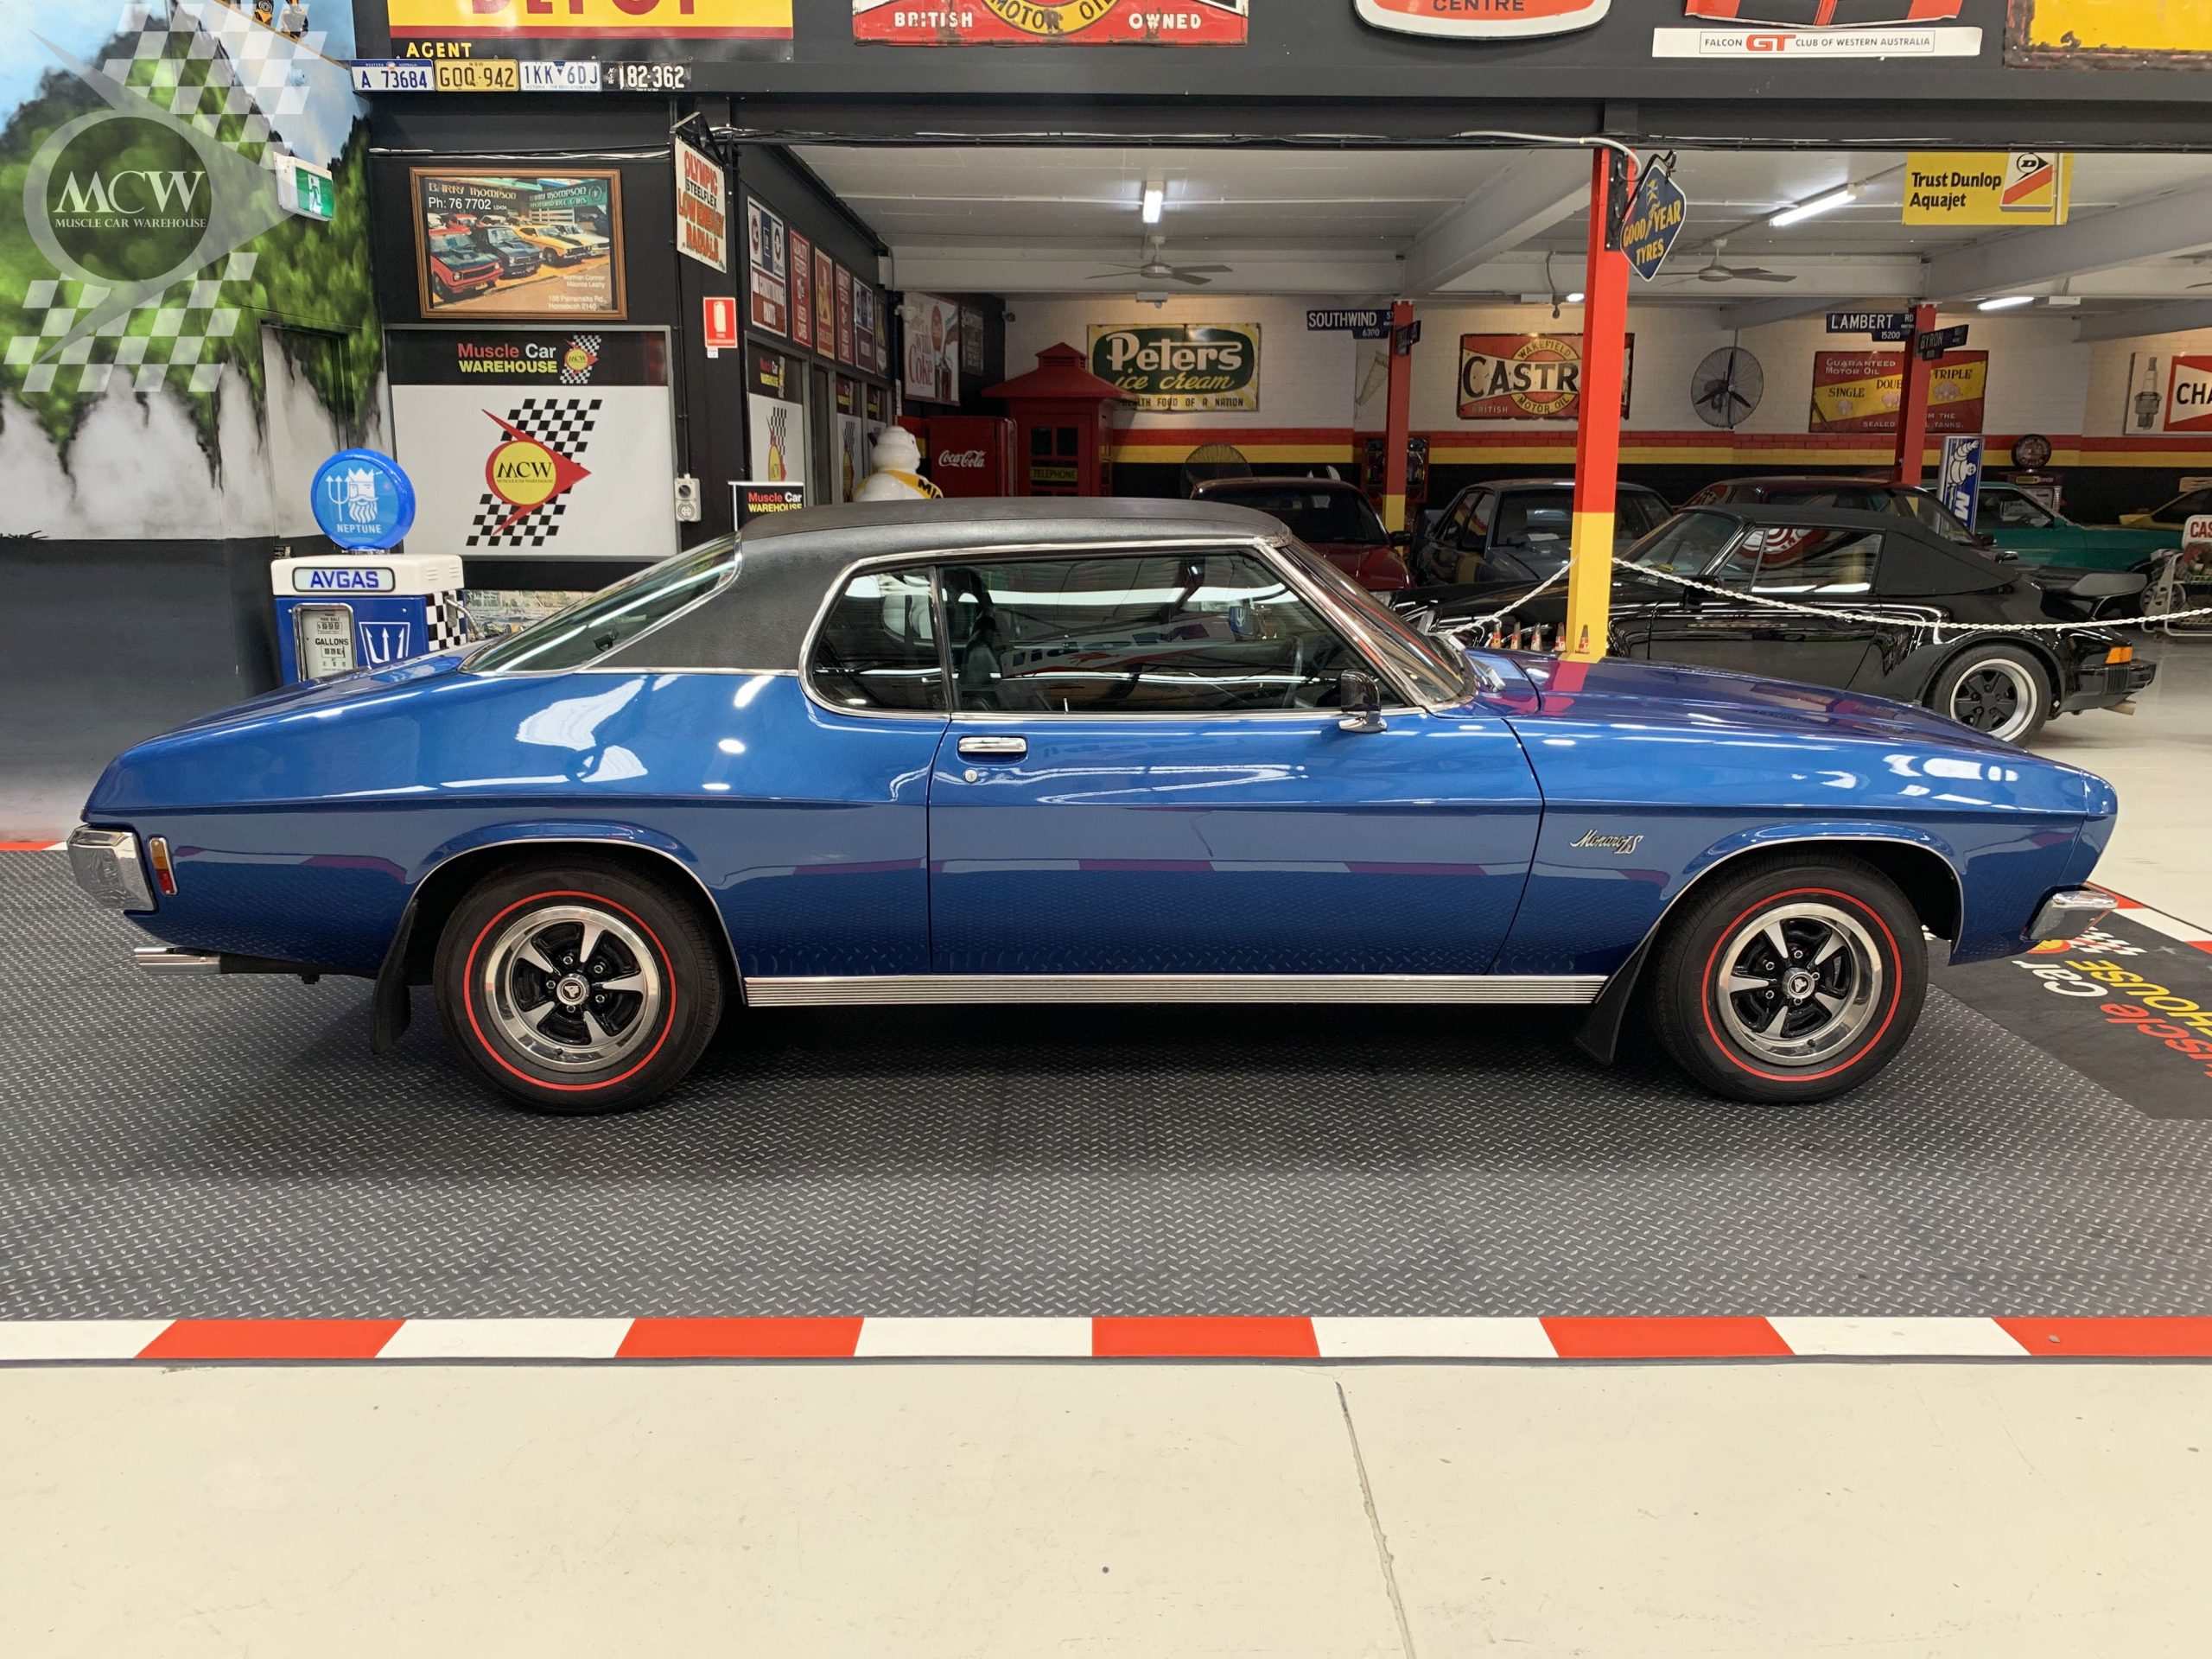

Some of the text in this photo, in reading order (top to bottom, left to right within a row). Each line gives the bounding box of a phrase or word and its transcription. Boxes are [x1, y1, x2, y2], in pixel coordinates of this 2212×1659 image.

[894, 12, 1202, 29] BRITISH OWNED
[406, 42, 472, 58] AGENT
[1705, 34, 1930, 52] FALCON GT CLUB OF WESTERN AUSTRALIA
[361, 71, 428, 88] A 73684
[524, 66, 597, 84] 1KK 6DJ
[684, 150, 718, 197] OLYMPIC
[1911, 172, 2002, 190] Trust Dunlop
[685, 178, 717, 209] STEELFLEX
[1910, 192, 1966, 211] Aquajet
[429, 197, 447, 209] Ph:
[448, 198, 463, 209] 76
[465, 198, 492, 210] 7702
[1636, 238, 1664, 266] TYRES
[1308, 312, 1377, 327] SOUTHWIND
[1831, 314, 1893, 329] LAMBERT
[1362, 328, 1380, 337] 6300
[1881, 331, 1900, 340] 15200
[457, 343, 556, 359] Muscle Car
[1106, 332, 1243, 371] Peters
[1517, 340, 1572, 359] WAKEFIELD
[458, 359, 557, 373] WAREHOUSE
[1825, 366, 1859, 375] MOTOR
[1826, 359, 1896, 368] GUARANTEED
[1159, 372, 1235, 390] cream
[1933, 368, 1974, 380] TRIPLE
[1828, 387, 1865, 397] SINGLE
[1215, 397, 1243, 407] NATION
[1517, 394, 1570, 414] MOTOR OIL
[497, 461, 552, 478] MCW
[748, 493, 802, 503] Muscle Car
[337, 524, 382, 534] NEPTUNE
[310, 570, 379, 588] AVGAS
[2012, 960, 2109, 997] Car
